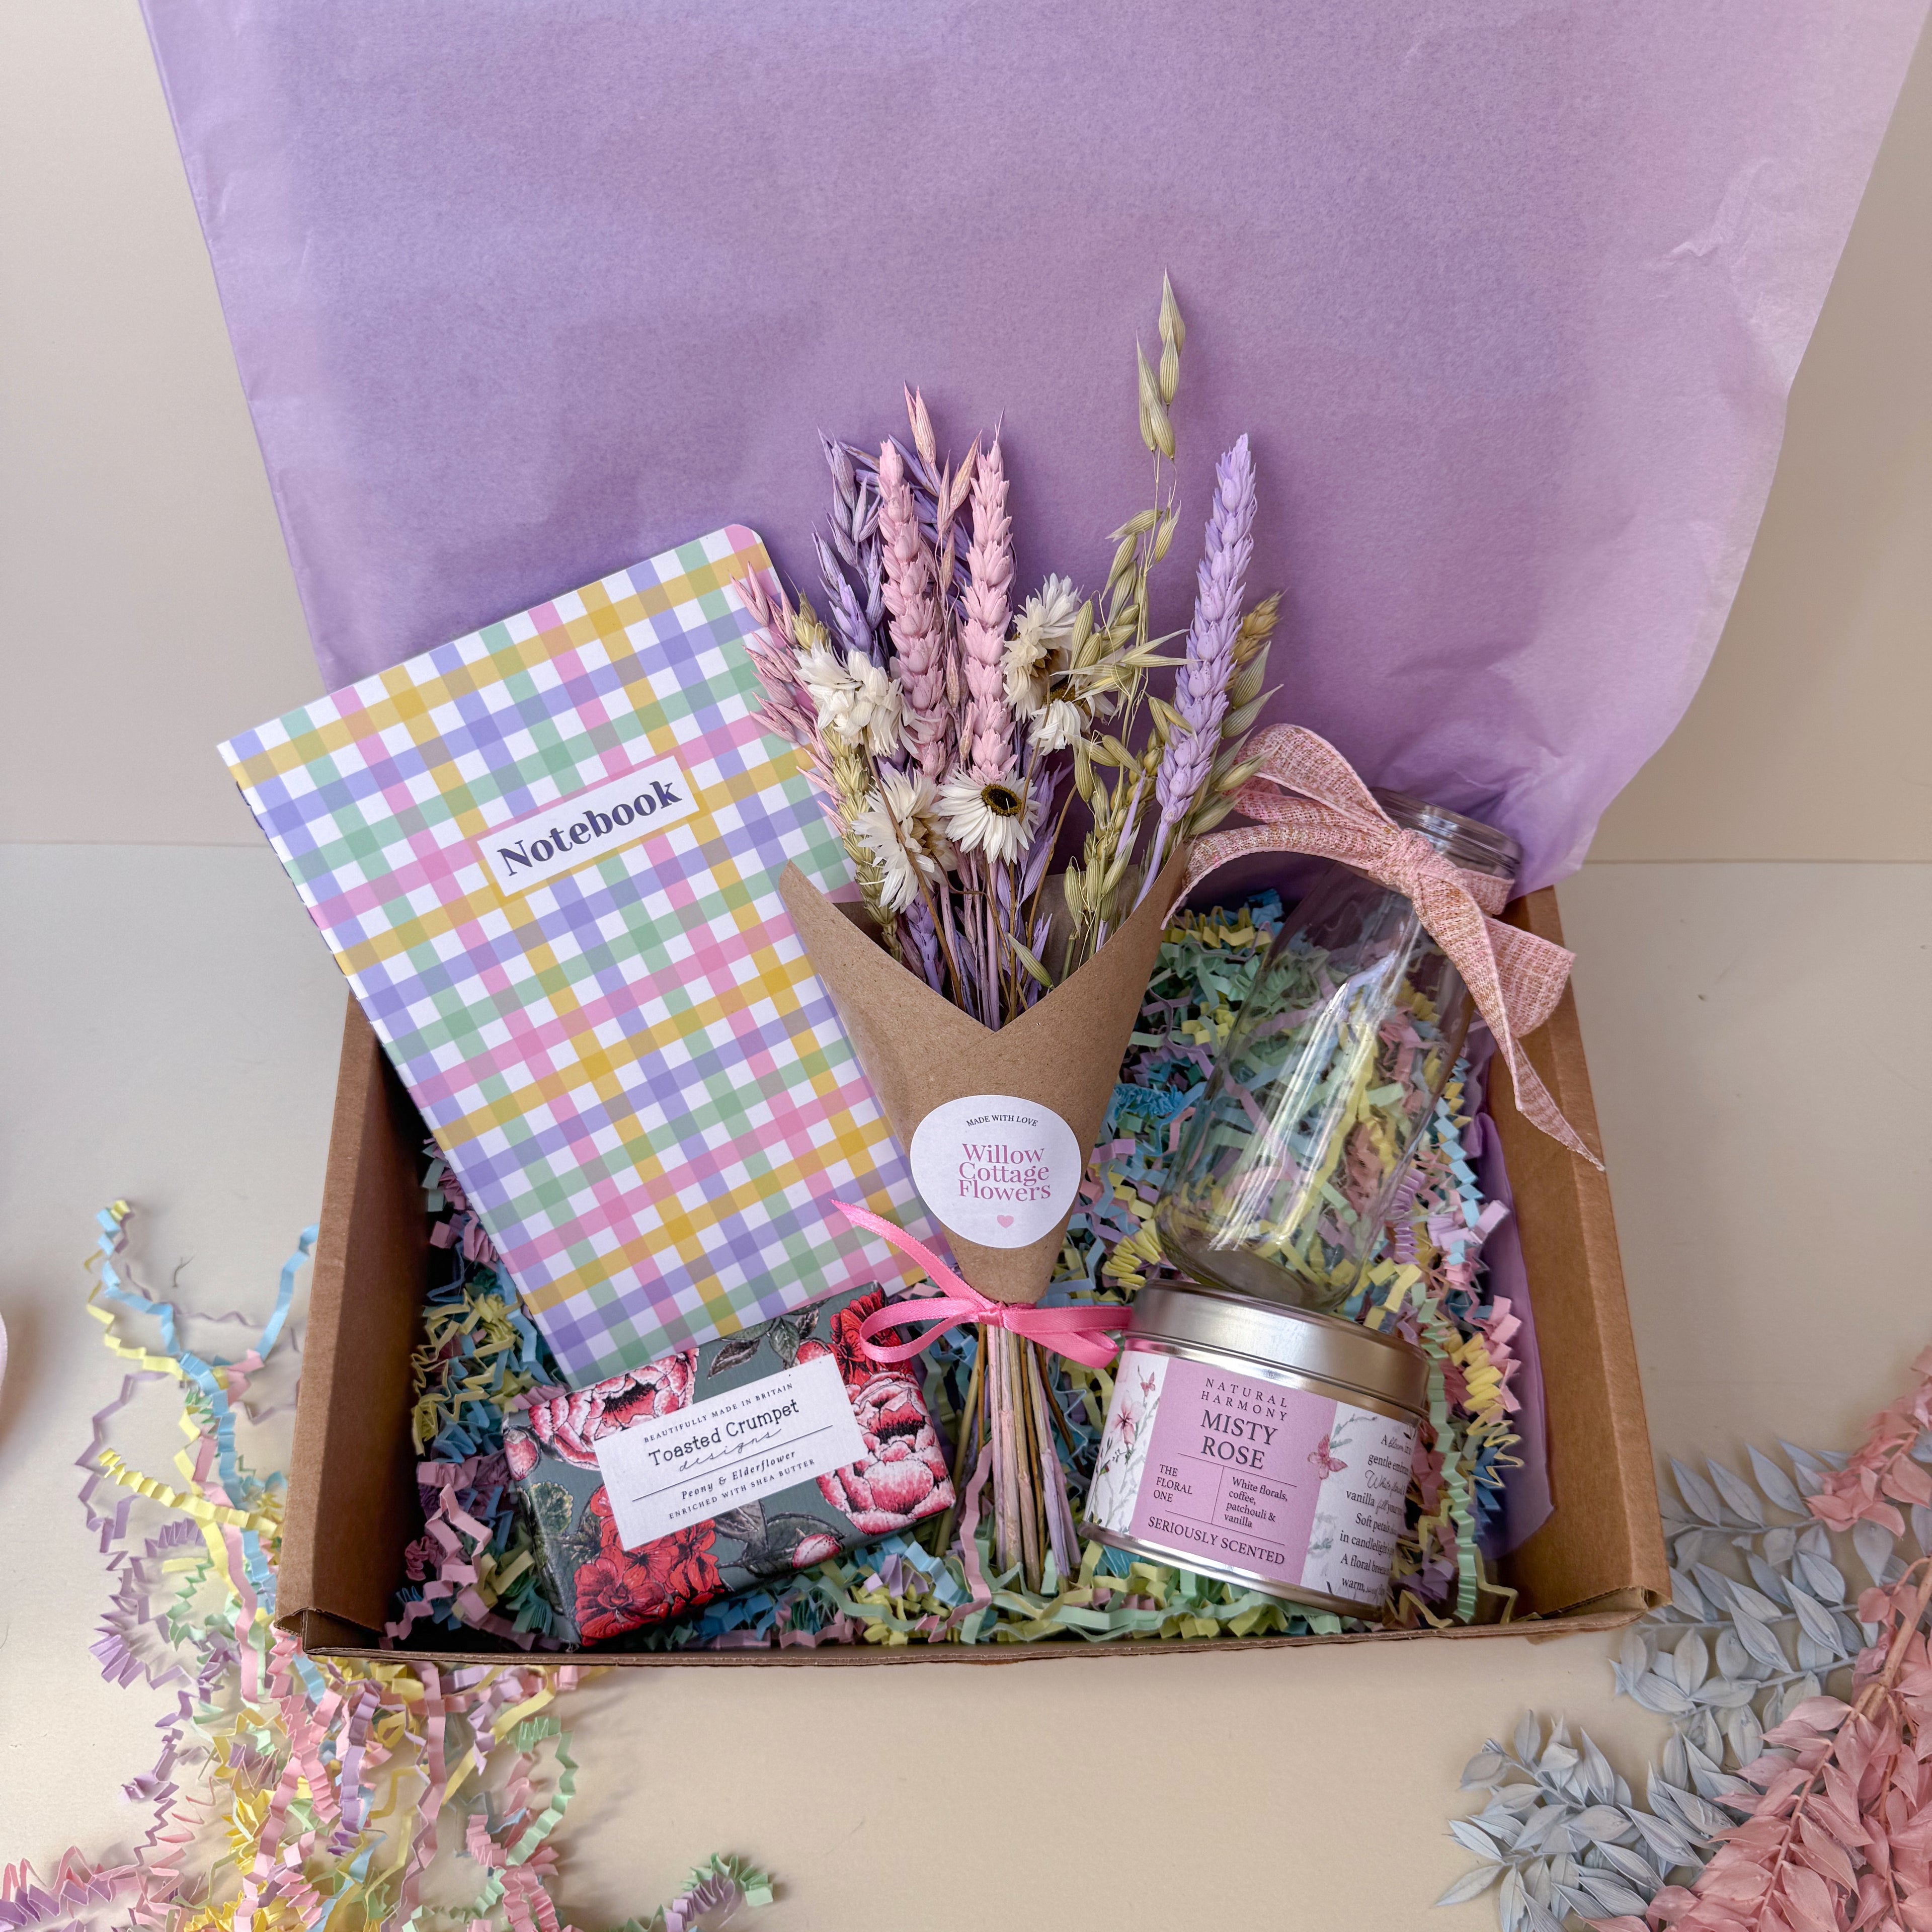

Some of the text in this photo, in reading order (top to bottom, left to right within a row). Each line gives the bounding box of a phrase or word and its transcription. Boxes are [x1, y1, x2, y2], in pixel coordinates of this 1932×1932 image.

[497, 781, 682, 876] Notebook
[966, 1115, 990, 1126] MADE
[1016, 1116, 1038, 1126] LOVE
[962, 1143, 1044, 1164] Willow
[959, 1162, 1049, 1186] Cottage
[958, 1179, 1051, 1201] Flowers
[1205, 1378, 1287, 1408] NATURAL
[644, 1415, 707, 1443] BEAUTIFULLY
[712, 1404, 738, 1418] MADE
[755, 1383, 793, 1401] BRITAIN
[1201, 1391, 1287, 1421] HARMONY
[649, 1399, 799, 1466] Toasted Crumpet
[1200, 1409, 1278, 1445] MISTY
[1381, 1434, 1387, 1445] A
[679, 1429, 781, 1472] designs
[1200, 1435, 1265, 1470] ROSE
[1367, 1454, 1392, 1468] gentle
[682, 1452, 795, 1500] Peony & Elderflower
[1159, 1464, 1178, 1477] THE
[669, 1459, 815, 1519] ENRICHED WITH SHEA BUTTER
[1153, 1490, 1173, 1502] ONE
[1156, 1477, 1192, 1495] FLORAL
[1232, 1477, 1288, 1502] White florals,
[1229, 1490, 1256, 1505] coffee,
[1346, 1491, 1375, 1506] vanilla
[1224, 1513, 1252, 1528] vanilla
[1226, 1502, 1276, 1522] patchouli &
[1355, 1512, 1372, 1527] Soft
[1148, 1516, 1285, 1564] SERIOUSLY SCENTED
[1340, 1530, 1349, 1543] in
[1340, 1553, 1348, 1565] A
[1350, 1555, 1372, 1571] floral
[1342, 1578, 1365, 1592] warm,
